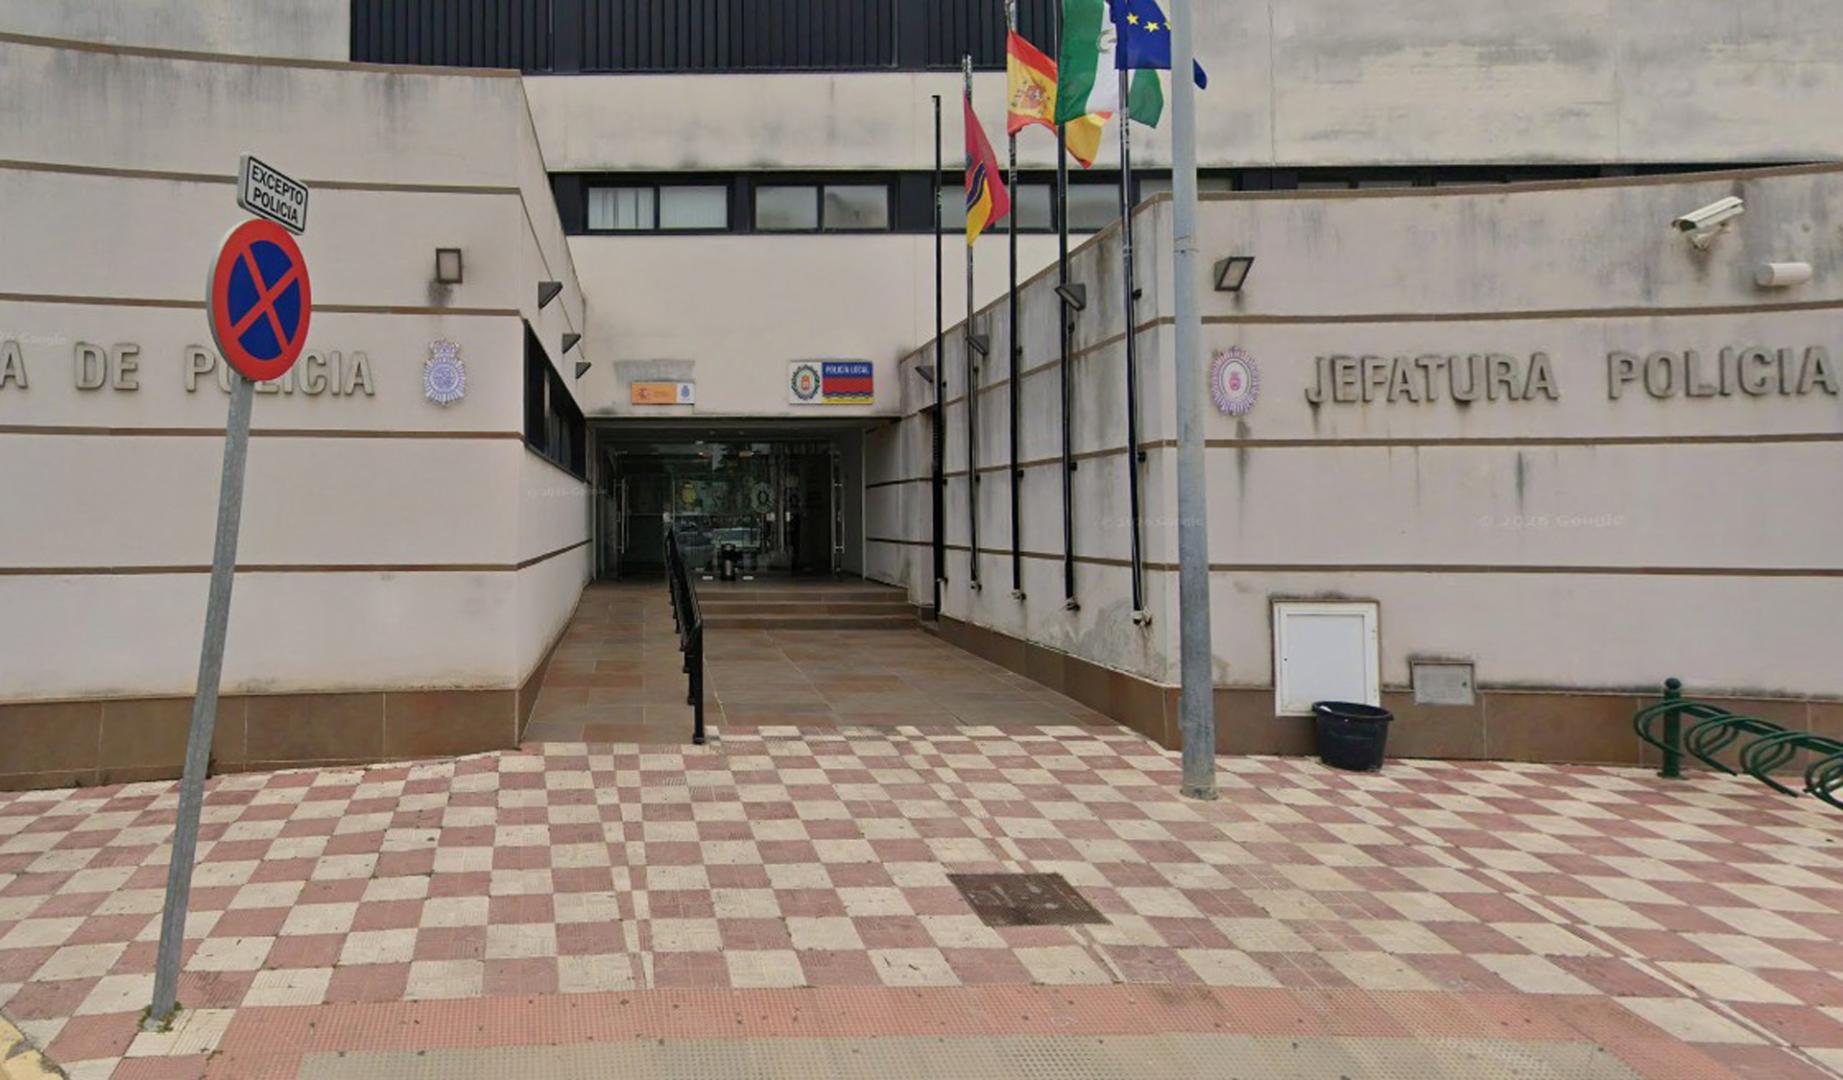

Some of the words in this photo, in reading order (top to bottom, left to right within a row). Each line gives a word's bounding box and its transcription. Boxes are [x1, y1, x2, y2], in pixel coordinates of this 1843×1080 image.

[251, 164, 304, 206] EXCEPTO
[253, 186, 299, 224] POLICIA
[74, 342, 139, 391] DE
[184, 344, 375, 396] PCIA
[1305, 352, 1559, 403] JEFATURA
[1607, 346, 1838, 400] POLICIA
